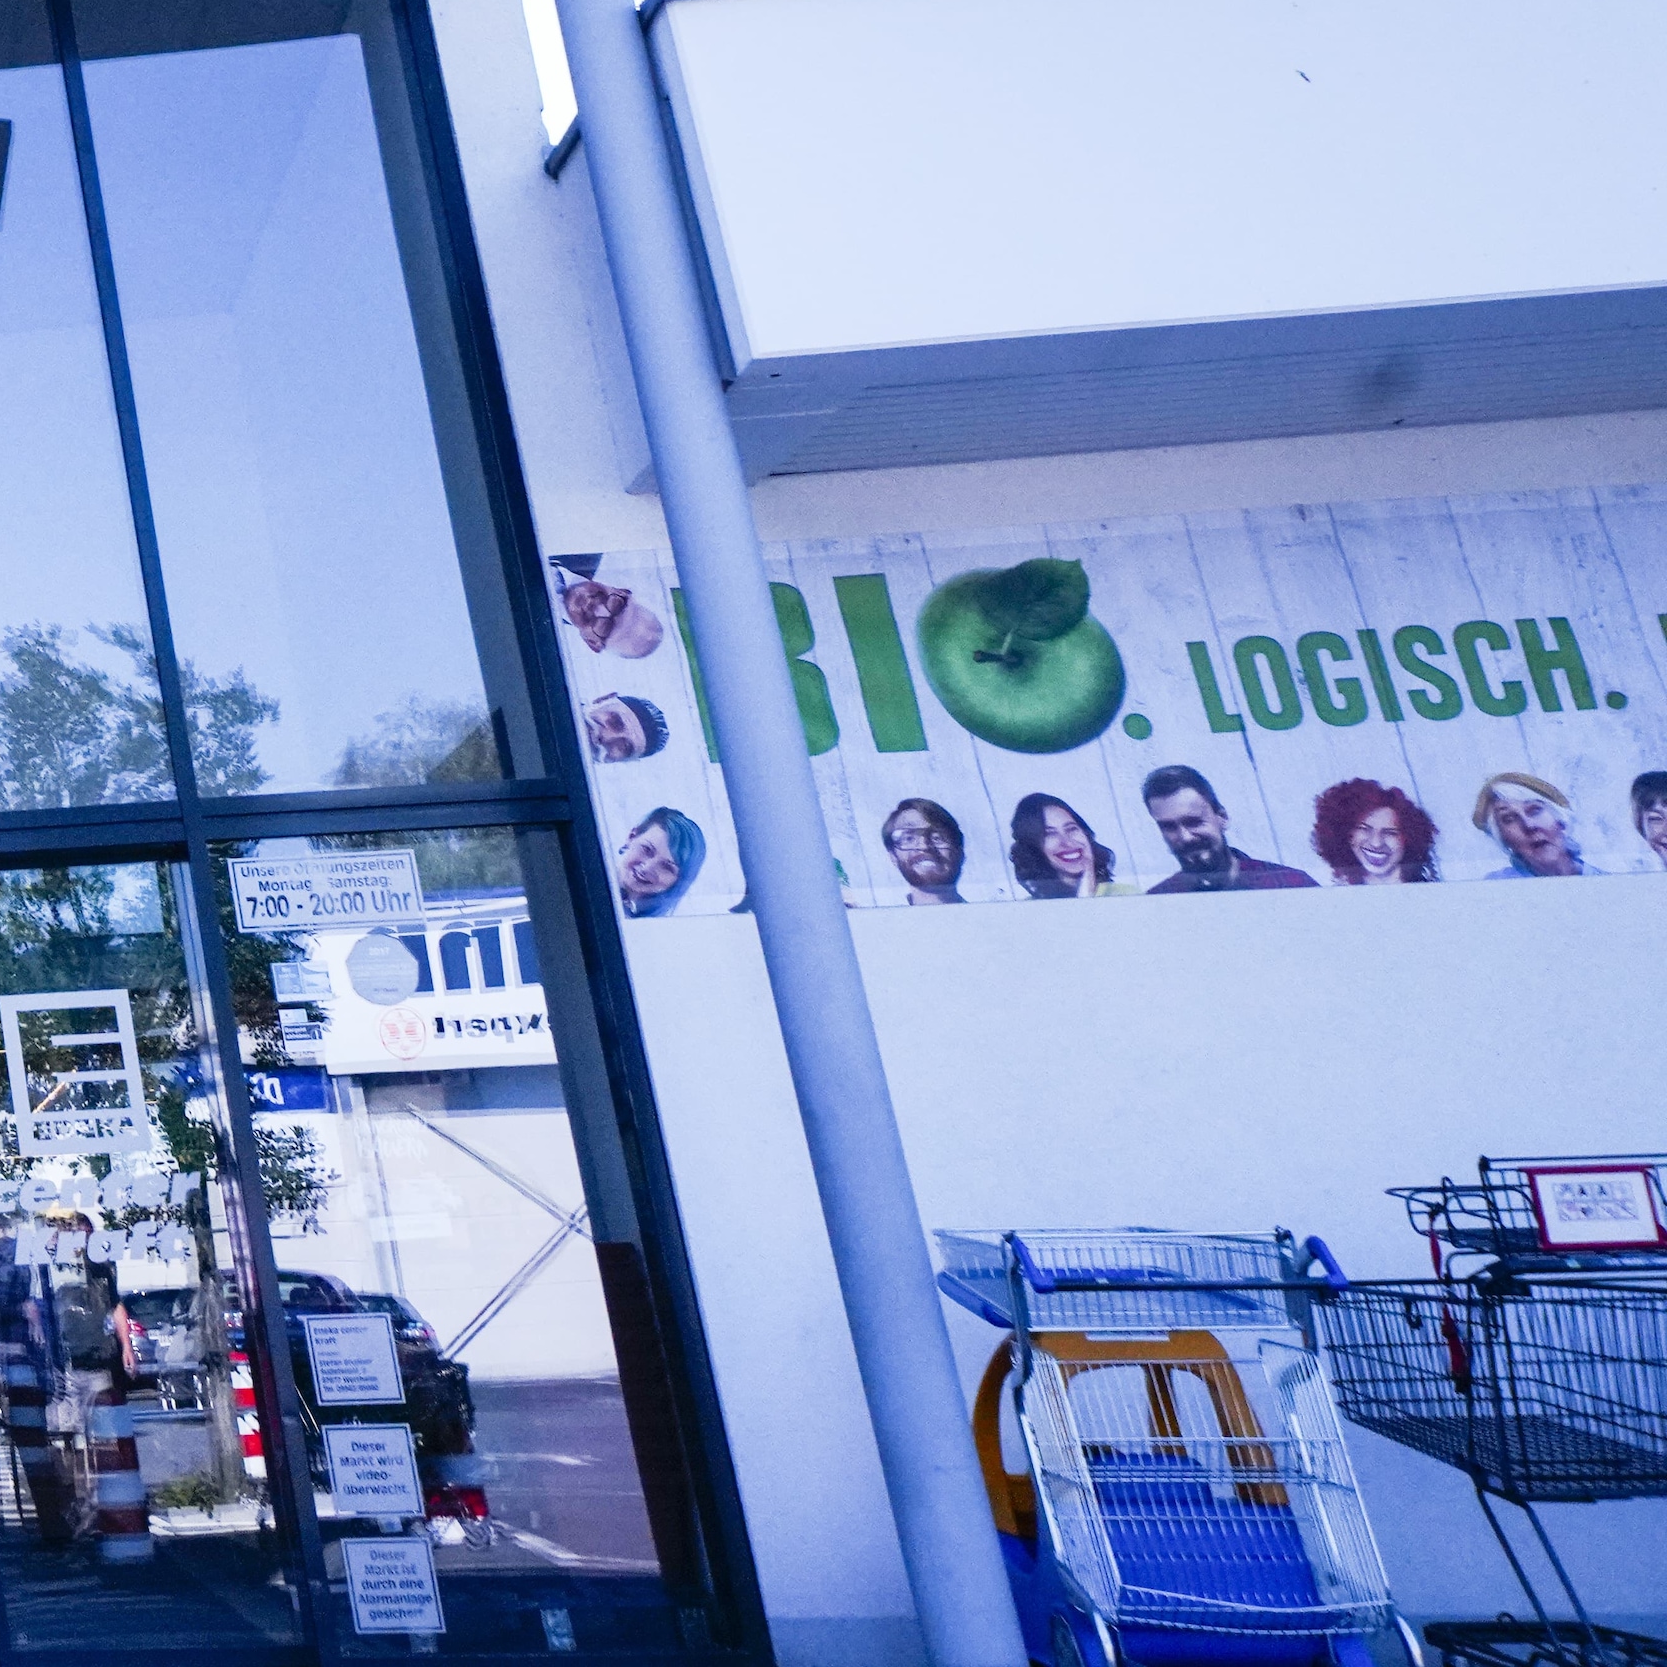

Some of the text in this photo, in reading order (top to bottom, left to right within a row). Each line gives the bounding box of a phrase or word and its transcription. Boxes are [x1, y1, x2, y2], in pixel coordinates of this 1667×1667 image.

[1186, 616, 1628, 733] LOGISCH.
[258, 879, 312, 892] Montag
[246, 895, 290, 919] 7:00
[309, 891, 366, 916] 20:00
[371, 889, 412, 913] Uhr
[32, 1116, 134, 1141] EDEKA
[351, 1441, 386, 1452] Dieser
[339, 1455, 404, 1467] Markt wird
[369, 1549, 407, 1561] Dieser
[364, 1564, 400, 1575] Markt
[361, 1579, 426, 1590] durch eine
[358, 1593, 433, 1606] Alarmanlage
